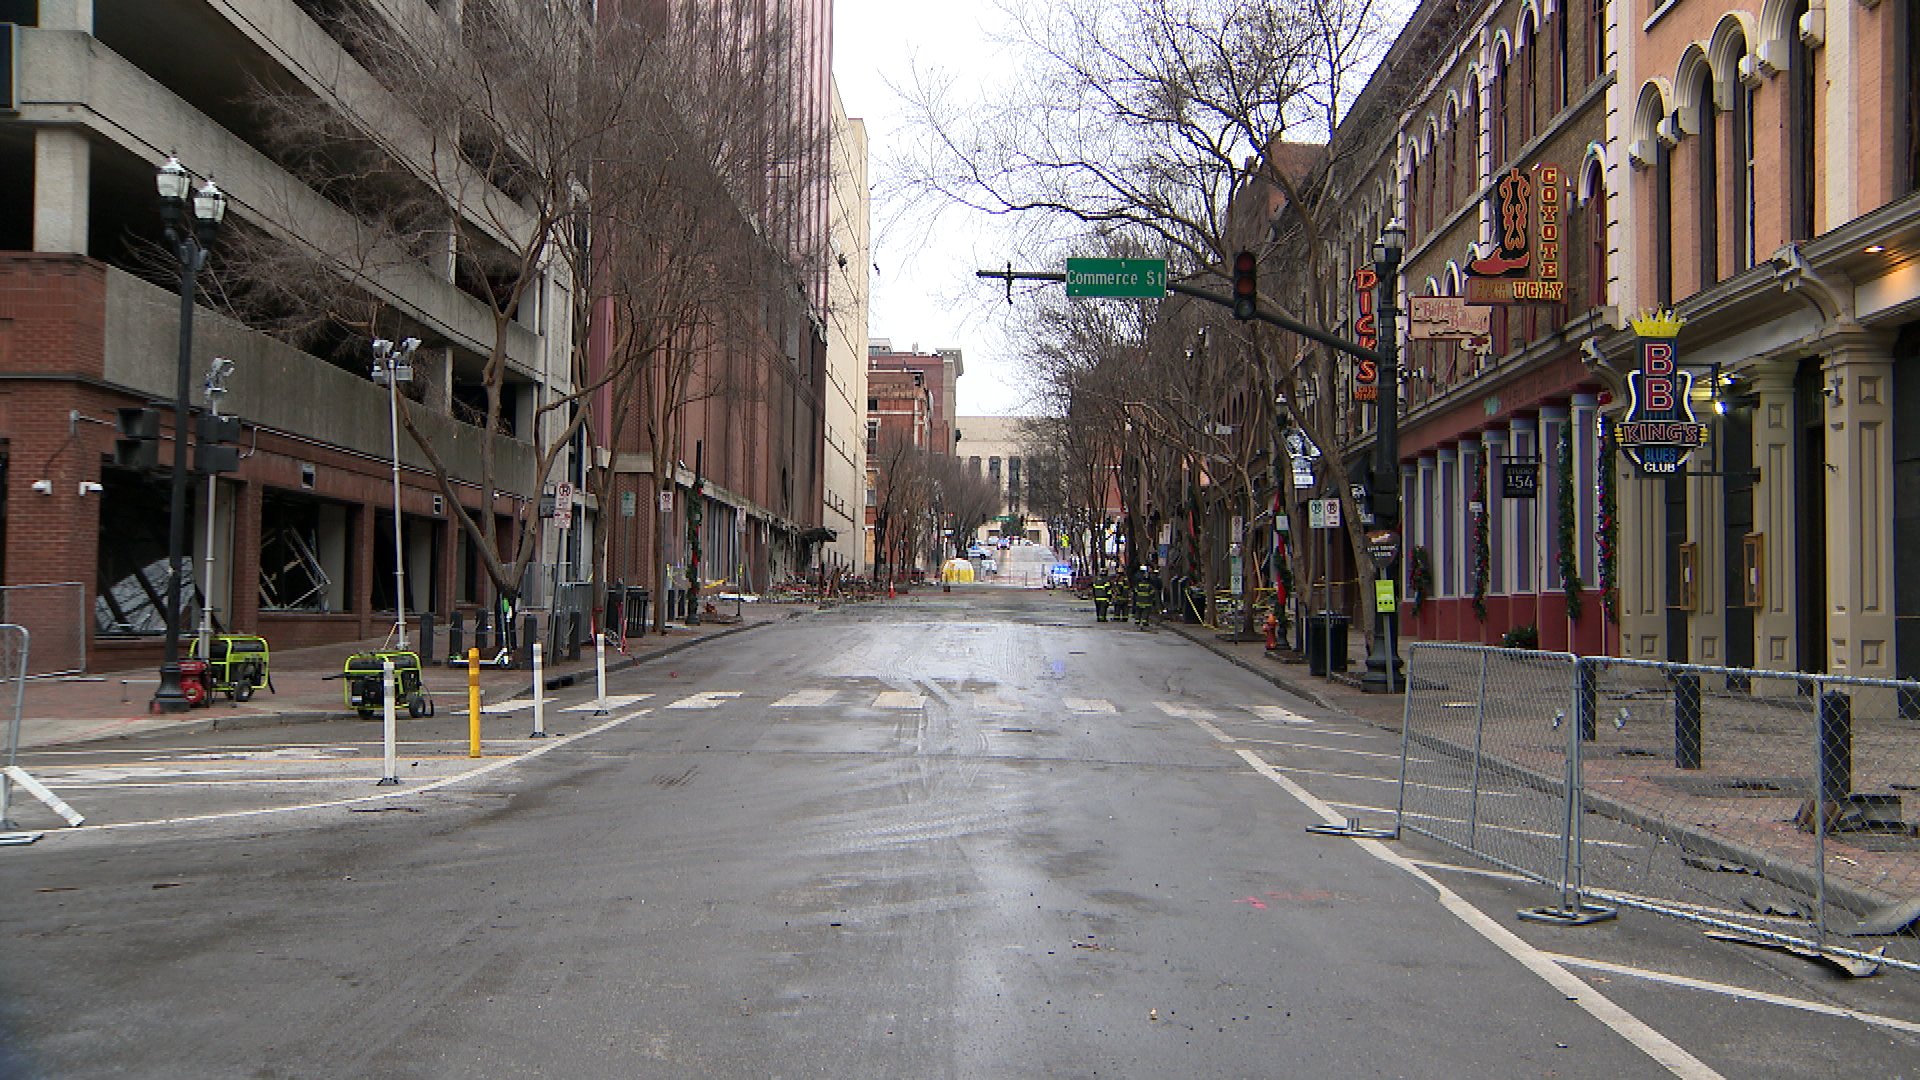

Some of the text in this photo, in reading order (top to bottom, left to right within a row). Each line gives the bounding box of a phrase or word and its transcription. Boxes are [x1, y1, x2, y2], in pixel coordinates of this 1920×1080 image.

[1540, 167, 1559, 279] COYOTE
[1067, 269, 1164, 286] Commerce St
[1512, 281, 1564, 300] UGLY
[1623, 424, 1698, 443] KING'S
[1644, 448, 1676, 463] BLUES
[1643, 462, 1676, 473] CLUB
[1507, 475, 1534, 489] 154
